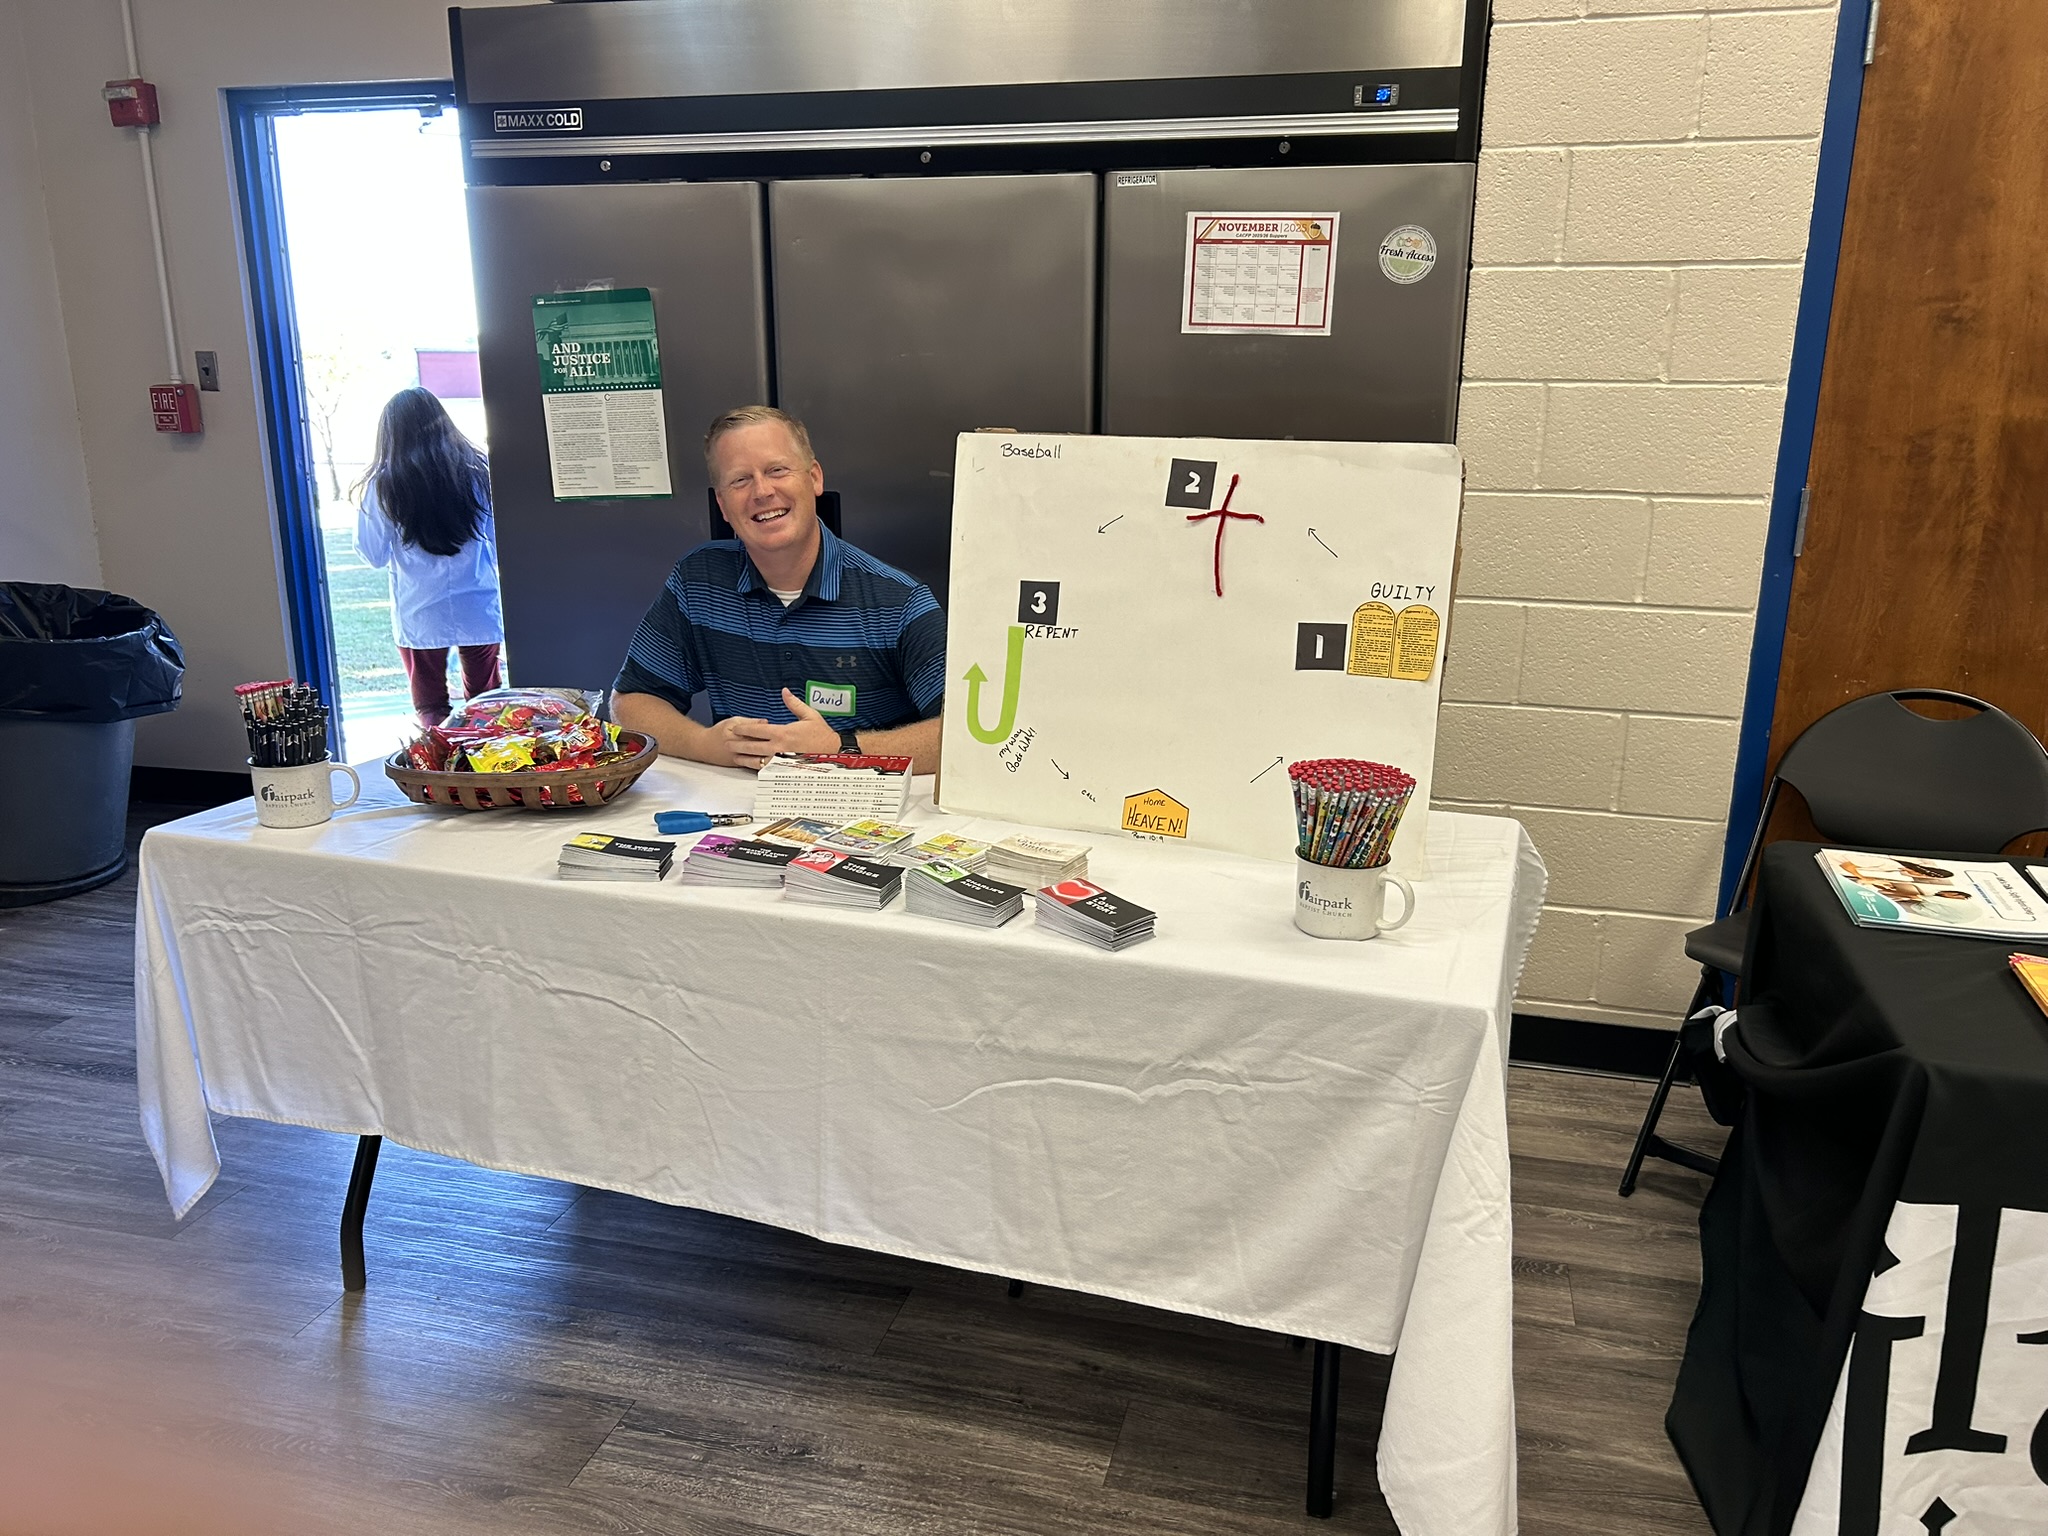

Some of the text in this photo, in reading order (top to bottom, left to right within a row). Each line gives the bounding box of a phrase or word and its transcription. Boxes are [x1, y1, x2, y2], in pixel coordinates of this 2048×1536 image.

[508, 113, 579, 127] MAXX COLD
[1118, 175, 1156, 185] REFRIGERATOR
[1217, 223, 1308, 233] NOVEMBER 2025
[1380, 245, 1435, 262] Fresh Access
[552, 342, 581, 354] AND
[552, 353, 611, 366] JUSTICE
[570, 366, 596, 377] ALL
[152, 393, 175, 410] FIRE
[1000, 442, 1062, 459] Baseball
[1184, 470, 1201, 493] 2
[1370, 582, 1436, 601] GUILTY
[1030, 590, 1047, 614] 3
[1025, 624, 1079, 639] REPENT
[1315, 633, 1324, 659] 1
[812, 690, 843, 707] David
[1126, 804, 1184, 833] HEAVEN!
[841, 866, 880, 878] CHOICE
[847, 862, 867, 870] THE
[960, 880, 982, 891] ANTS
[1085, 900, 1118, 915] STORY
[1091, 898, 1118, 911] LOVE
[1322, 910, 1352, 918] CHURCH
